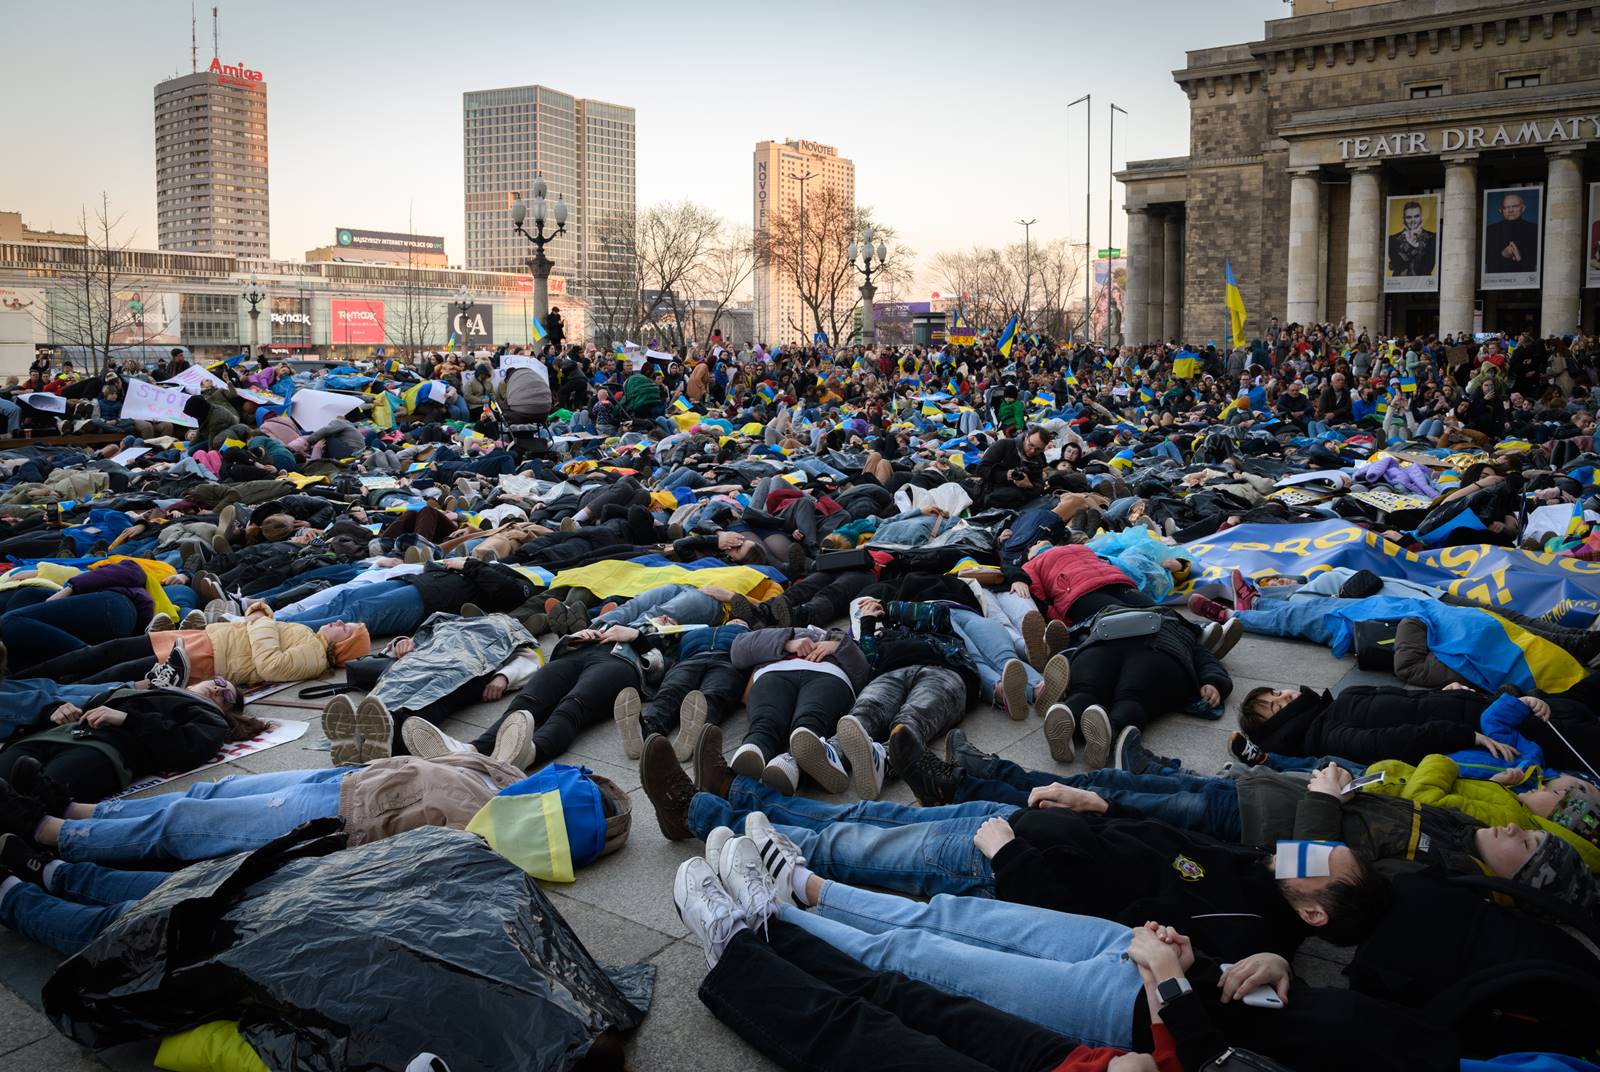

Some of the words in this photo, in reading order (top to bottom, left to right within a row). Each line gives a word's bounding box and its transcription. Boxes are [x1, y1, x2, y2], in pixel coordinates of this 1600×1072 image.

[801, 139, 836, 156] NOVOTEL
[1338, 132, 1430, 160] TEATR
[758, 161, 767, 228] NOVOTEL
[453, 313, 487, 336] C&A
